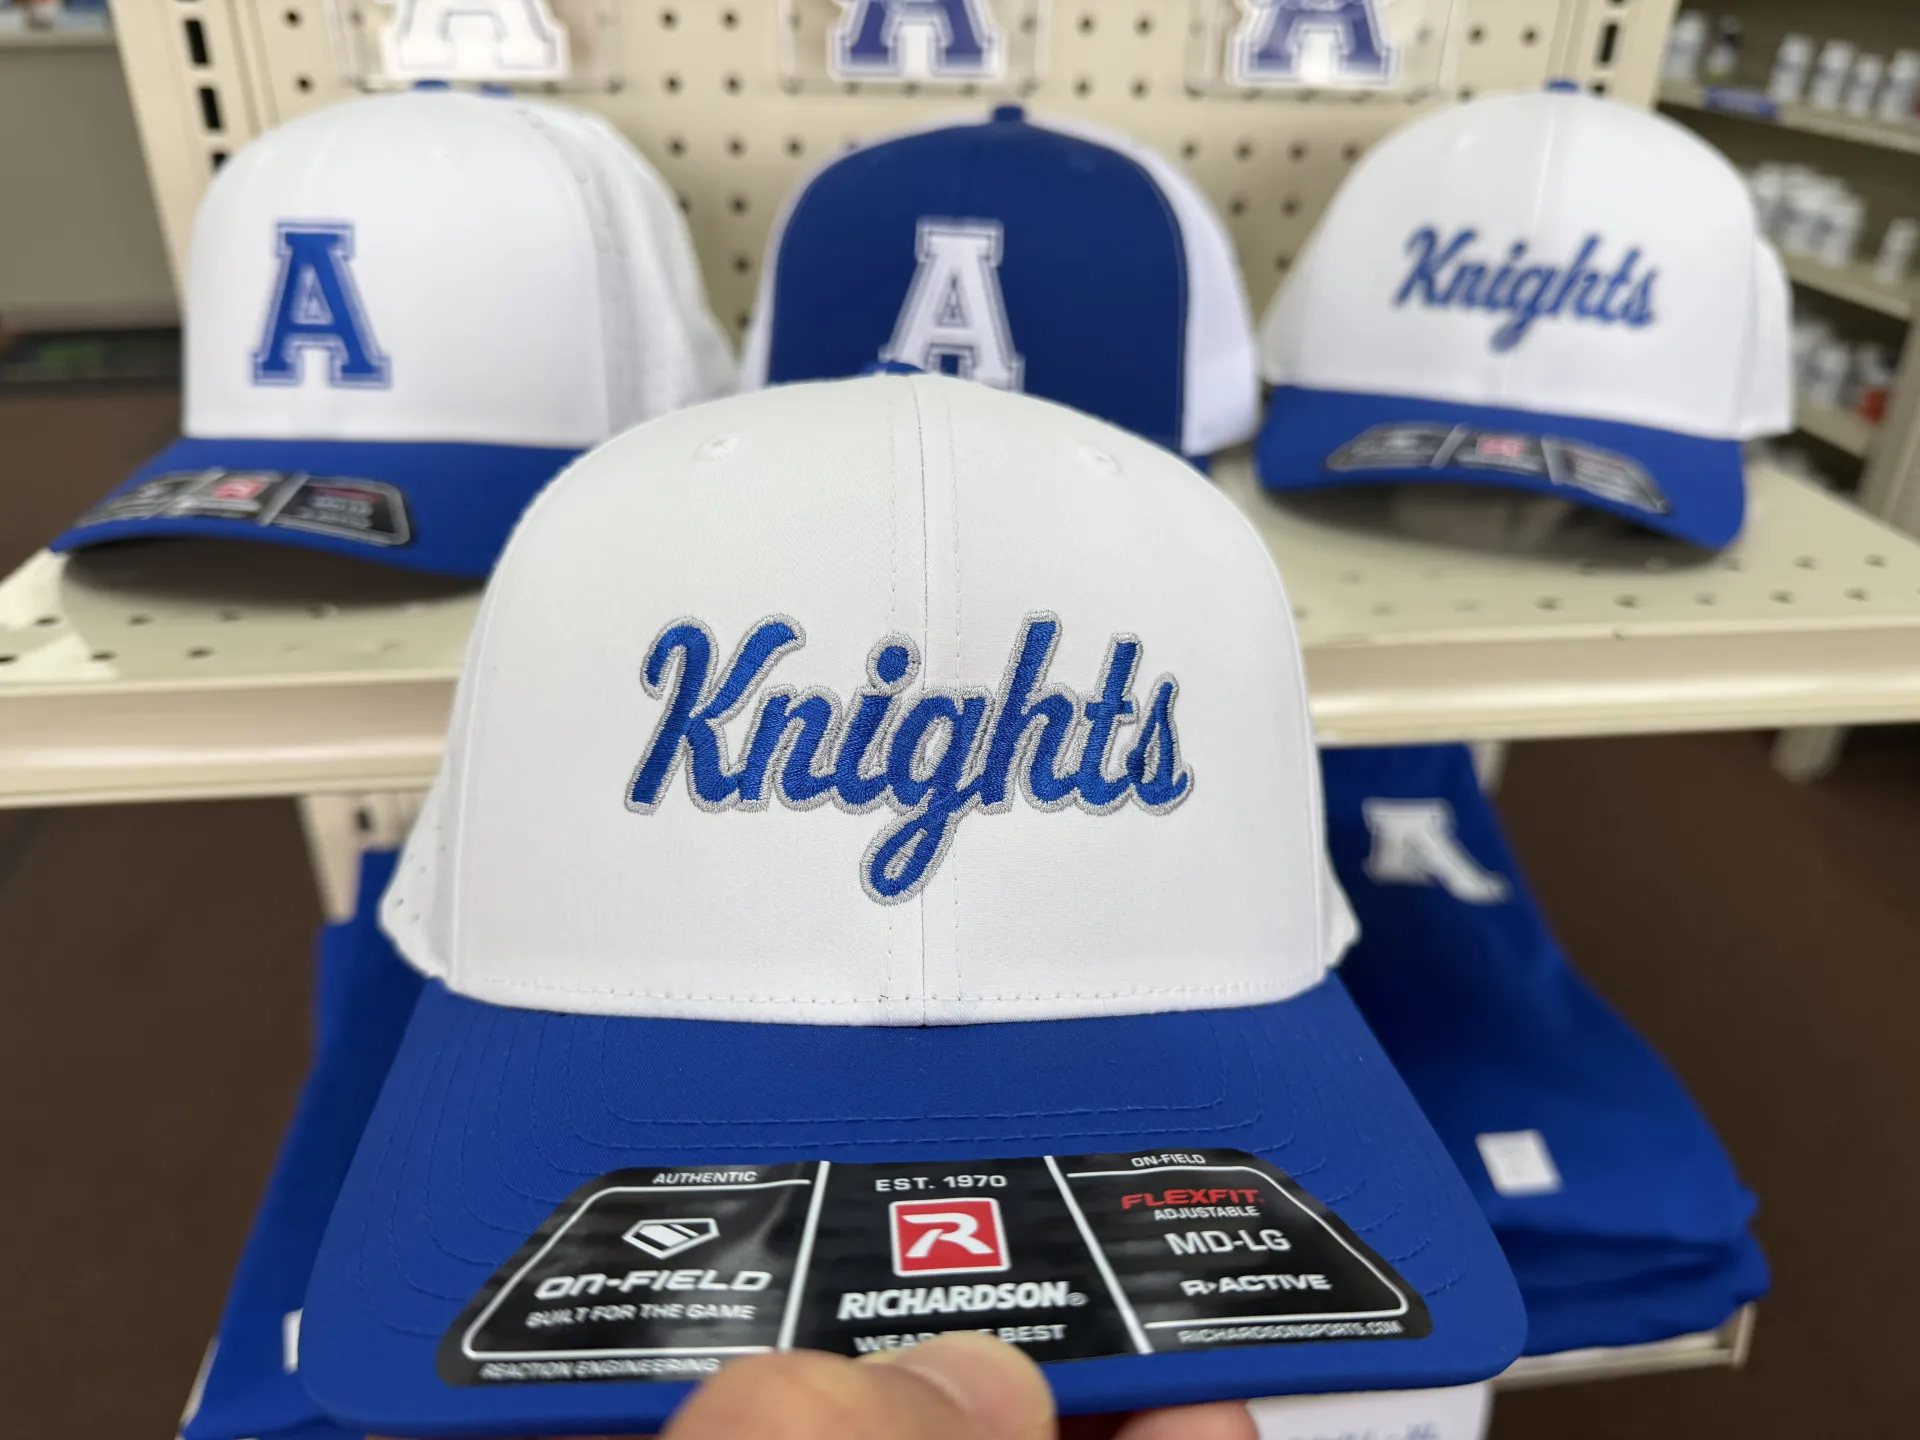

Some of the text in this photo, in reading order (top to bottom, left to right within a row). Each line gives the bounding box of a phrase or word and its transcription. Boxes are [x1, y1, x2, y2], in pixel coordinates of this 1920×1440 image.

[250, 218, 392, 389] A
[1391, 228, 1658, 353] Knights
[877, 216, 1026, 392] A
[624, 609, 1194, 905] Knights
[1130, 1153, 1207, 1168] ON-FIELD
[651, 1171, 758, 1185] AUTHENTIC
[875, 1174, 1008, 1192] EST. 1970
[1153, 1205, 1261, 1222] ADJUSTABLE
[901, 1212, 996, 1259] R
[1163, 1229, 1292, 1256] MD-LG
[525, 1303, 758, 1329] BUILT FOR THE GAME
[1000, 1324, 1068, 1343] BEST
[478, 1361, 574, 1381] REACTION
